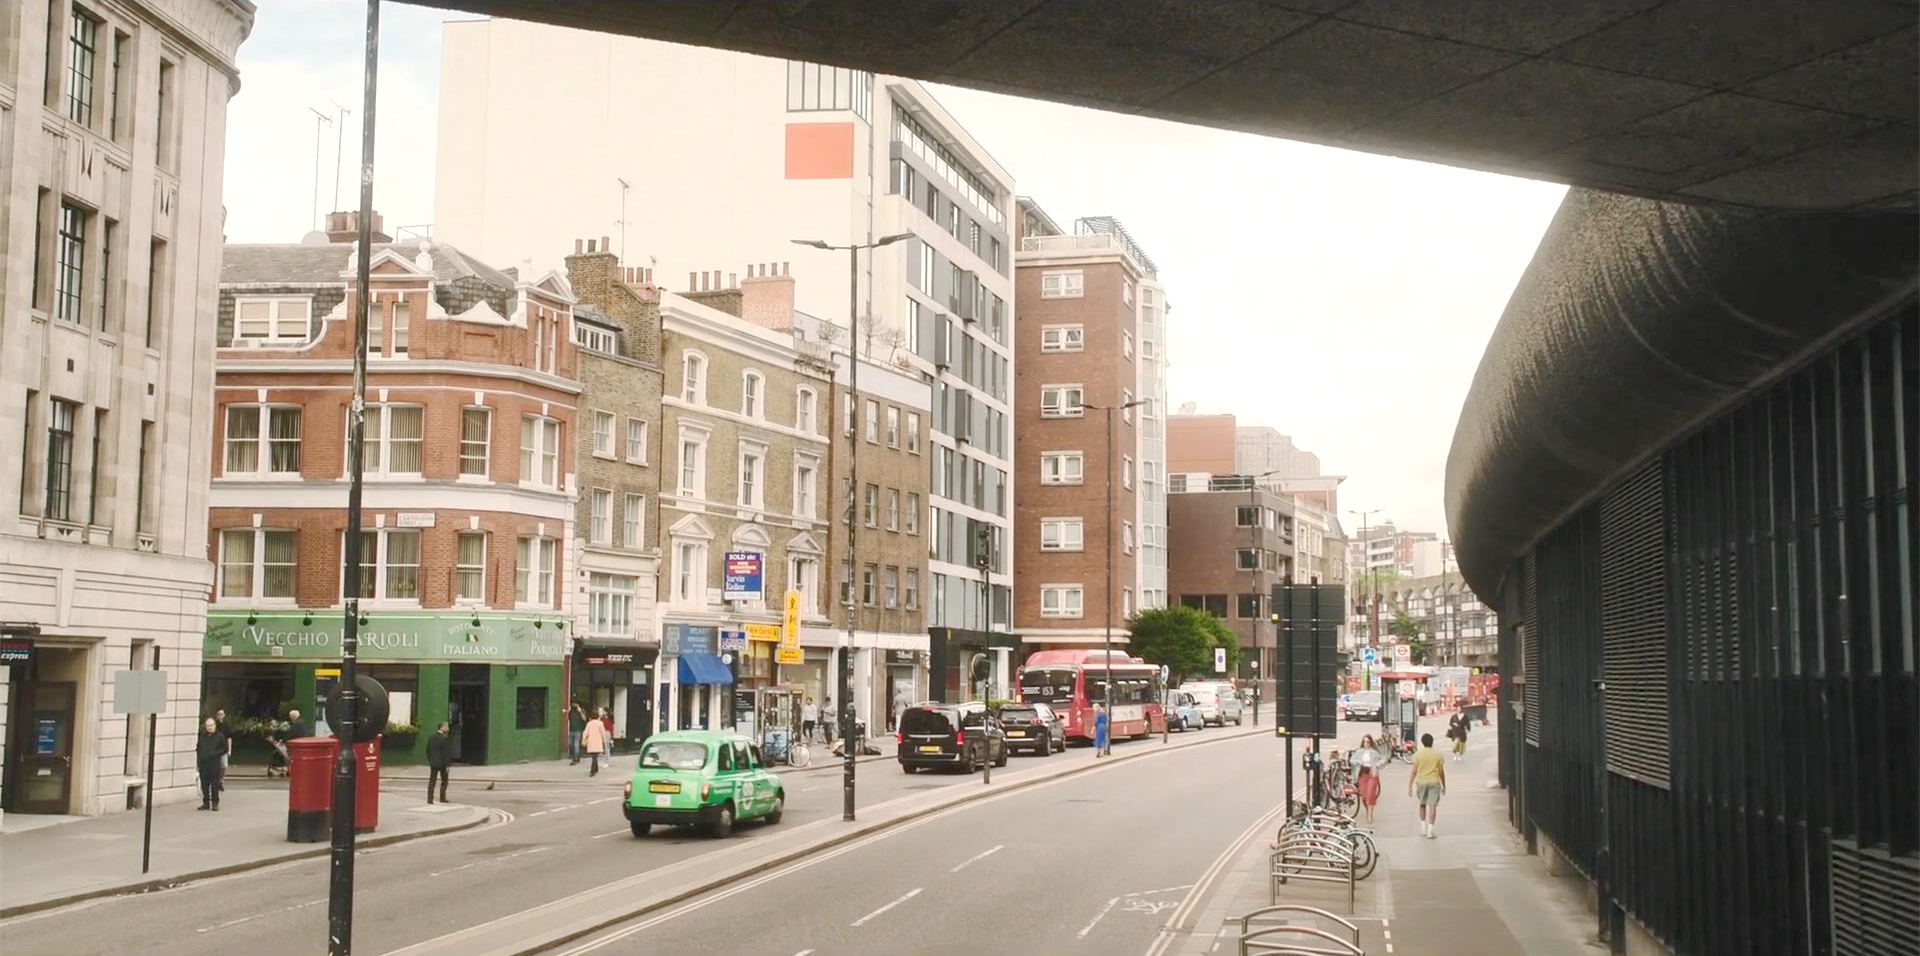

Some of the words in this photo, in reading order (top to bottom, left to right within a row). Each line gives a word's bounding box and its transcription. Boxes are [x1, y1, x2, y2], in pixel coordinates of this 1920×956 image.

[726, 574, 746, 583] Jarvis
[242, 626, 329, 647] VECCHIO
[340, 628, 419, 650] ARIOLI
[443, 643, 499, 655] ITALIANO
[1, 653, 29, 662] express
[1042, 686, 1055, 696] 153
